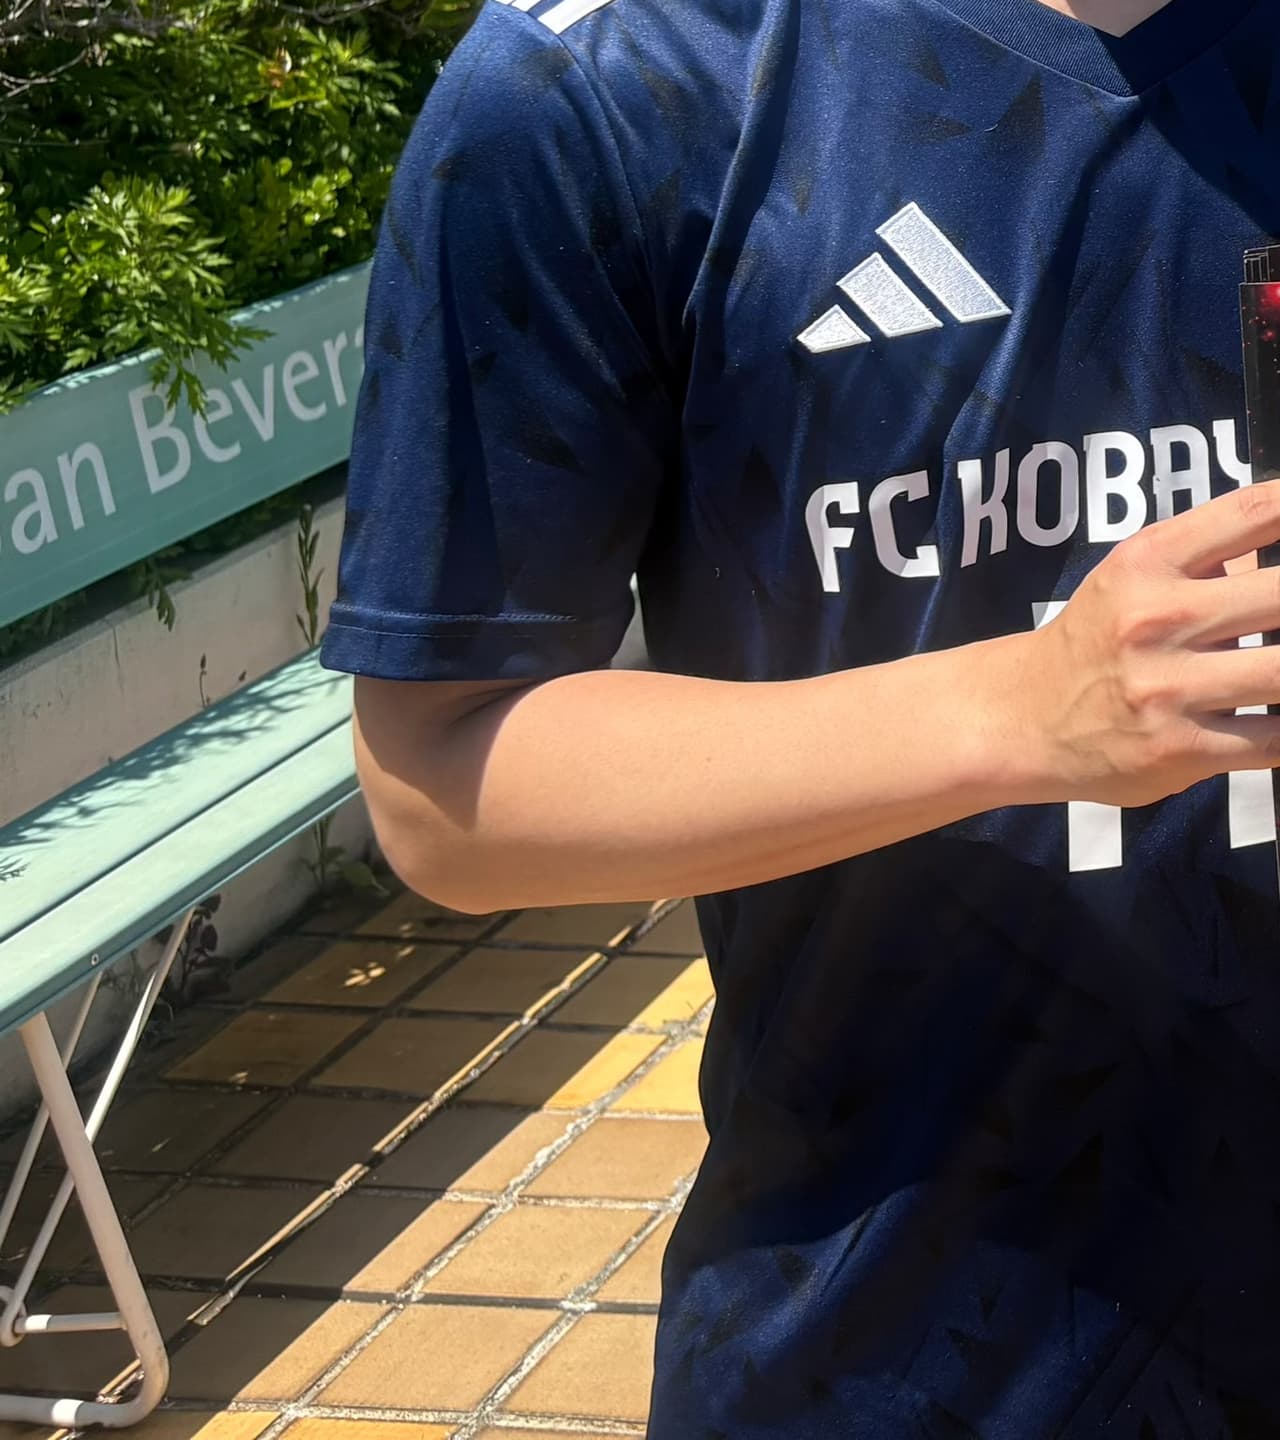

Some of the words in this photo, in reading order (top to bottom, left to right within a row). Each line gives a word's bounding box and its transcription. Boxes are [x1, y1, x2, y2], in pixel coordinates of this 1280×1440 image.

[0, 440, 117, 555] an
[128, 324, 366, 495] Bever
[805, 470, 941, 593] FC
